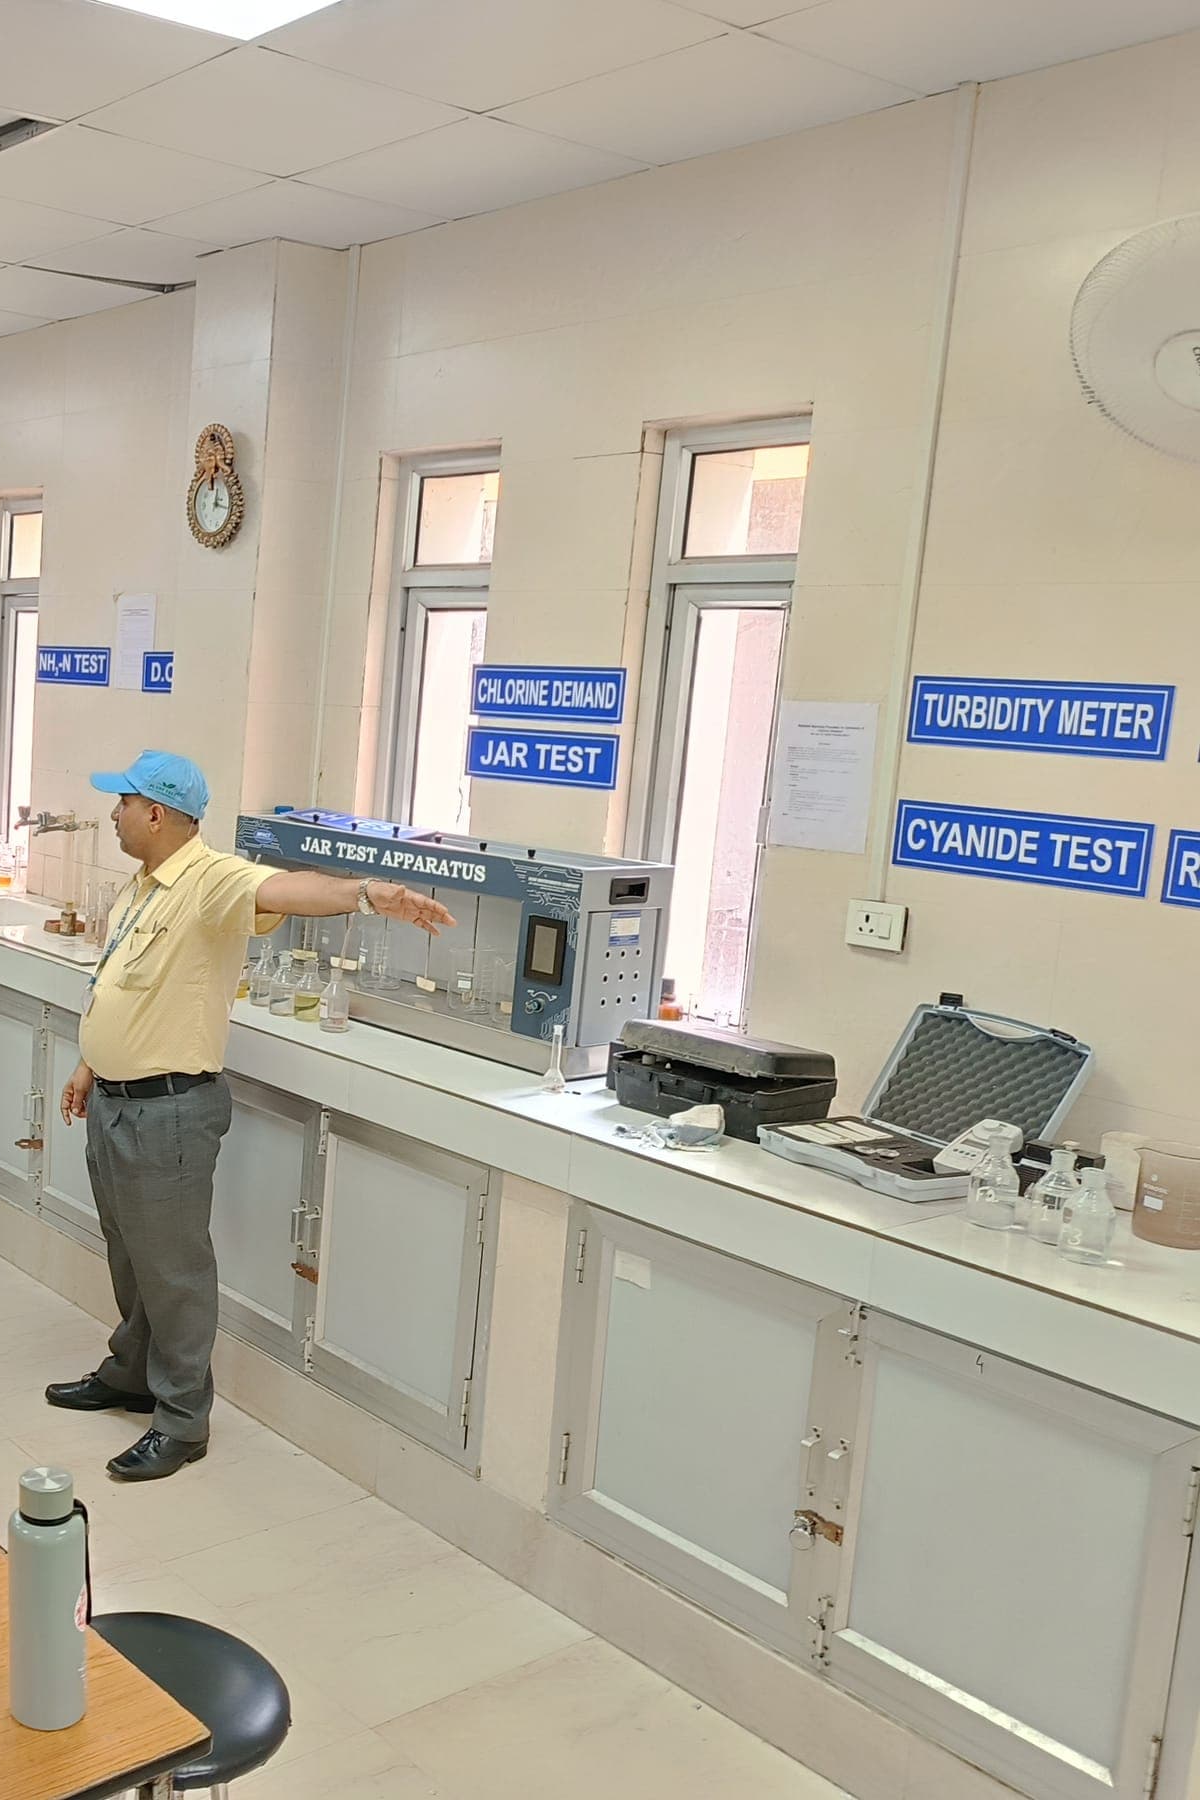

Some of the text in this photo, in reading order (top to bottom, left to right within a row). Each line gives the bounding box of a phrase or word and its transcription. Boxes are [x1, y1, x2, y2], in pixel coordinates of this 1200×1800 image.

[74, 654, 106, 674] TEST
[477, 677, 617, 710] CHLORINE DEMAND
[922, 693, 1155, 741] TURBIDITY METER
[479, 740, 602, 775] JAR TEST
[300, 836, 487, 884] JAR TEST APPARATUS
[906, 818, 1138, 876] CYANIDE TEST
[1178, 850, 1200, 889] R
